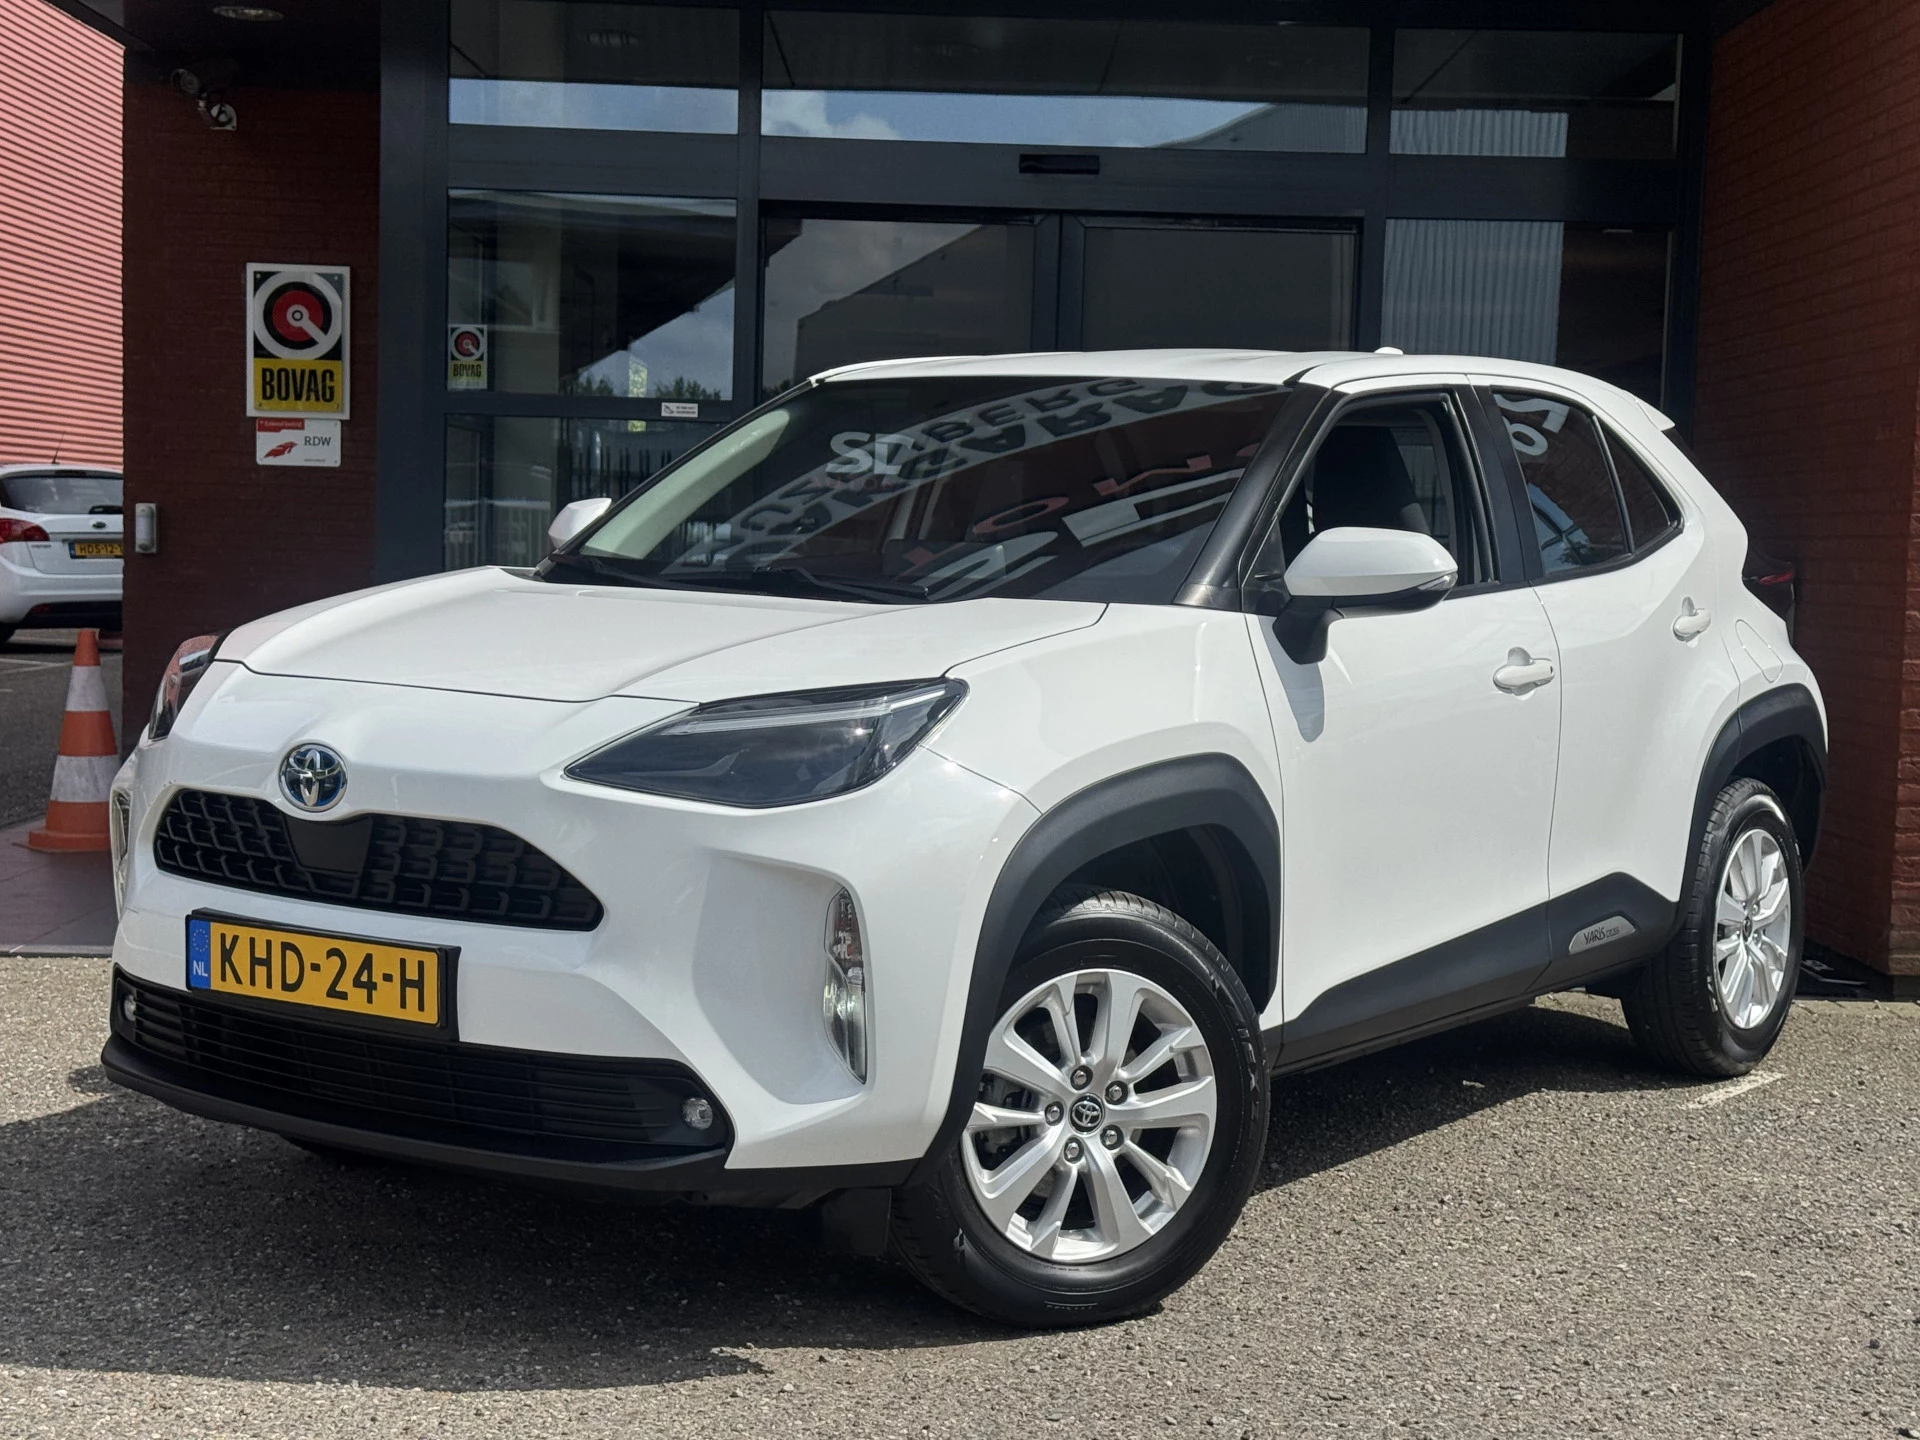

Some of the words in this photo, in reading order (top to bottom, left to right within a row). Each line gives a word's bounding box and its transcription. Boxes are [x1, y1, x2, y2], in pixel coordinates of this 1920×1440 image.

[453, 363, 482, 378] BOVAG
[261, 368, 335, 403] BOVAG
[304, 436, 331, 447] RDW
[1584, 926, 1606, 945] YARIS
[192, 960, 209, 977] NL
[220, 933, 425, 1012] KHD-24-H
